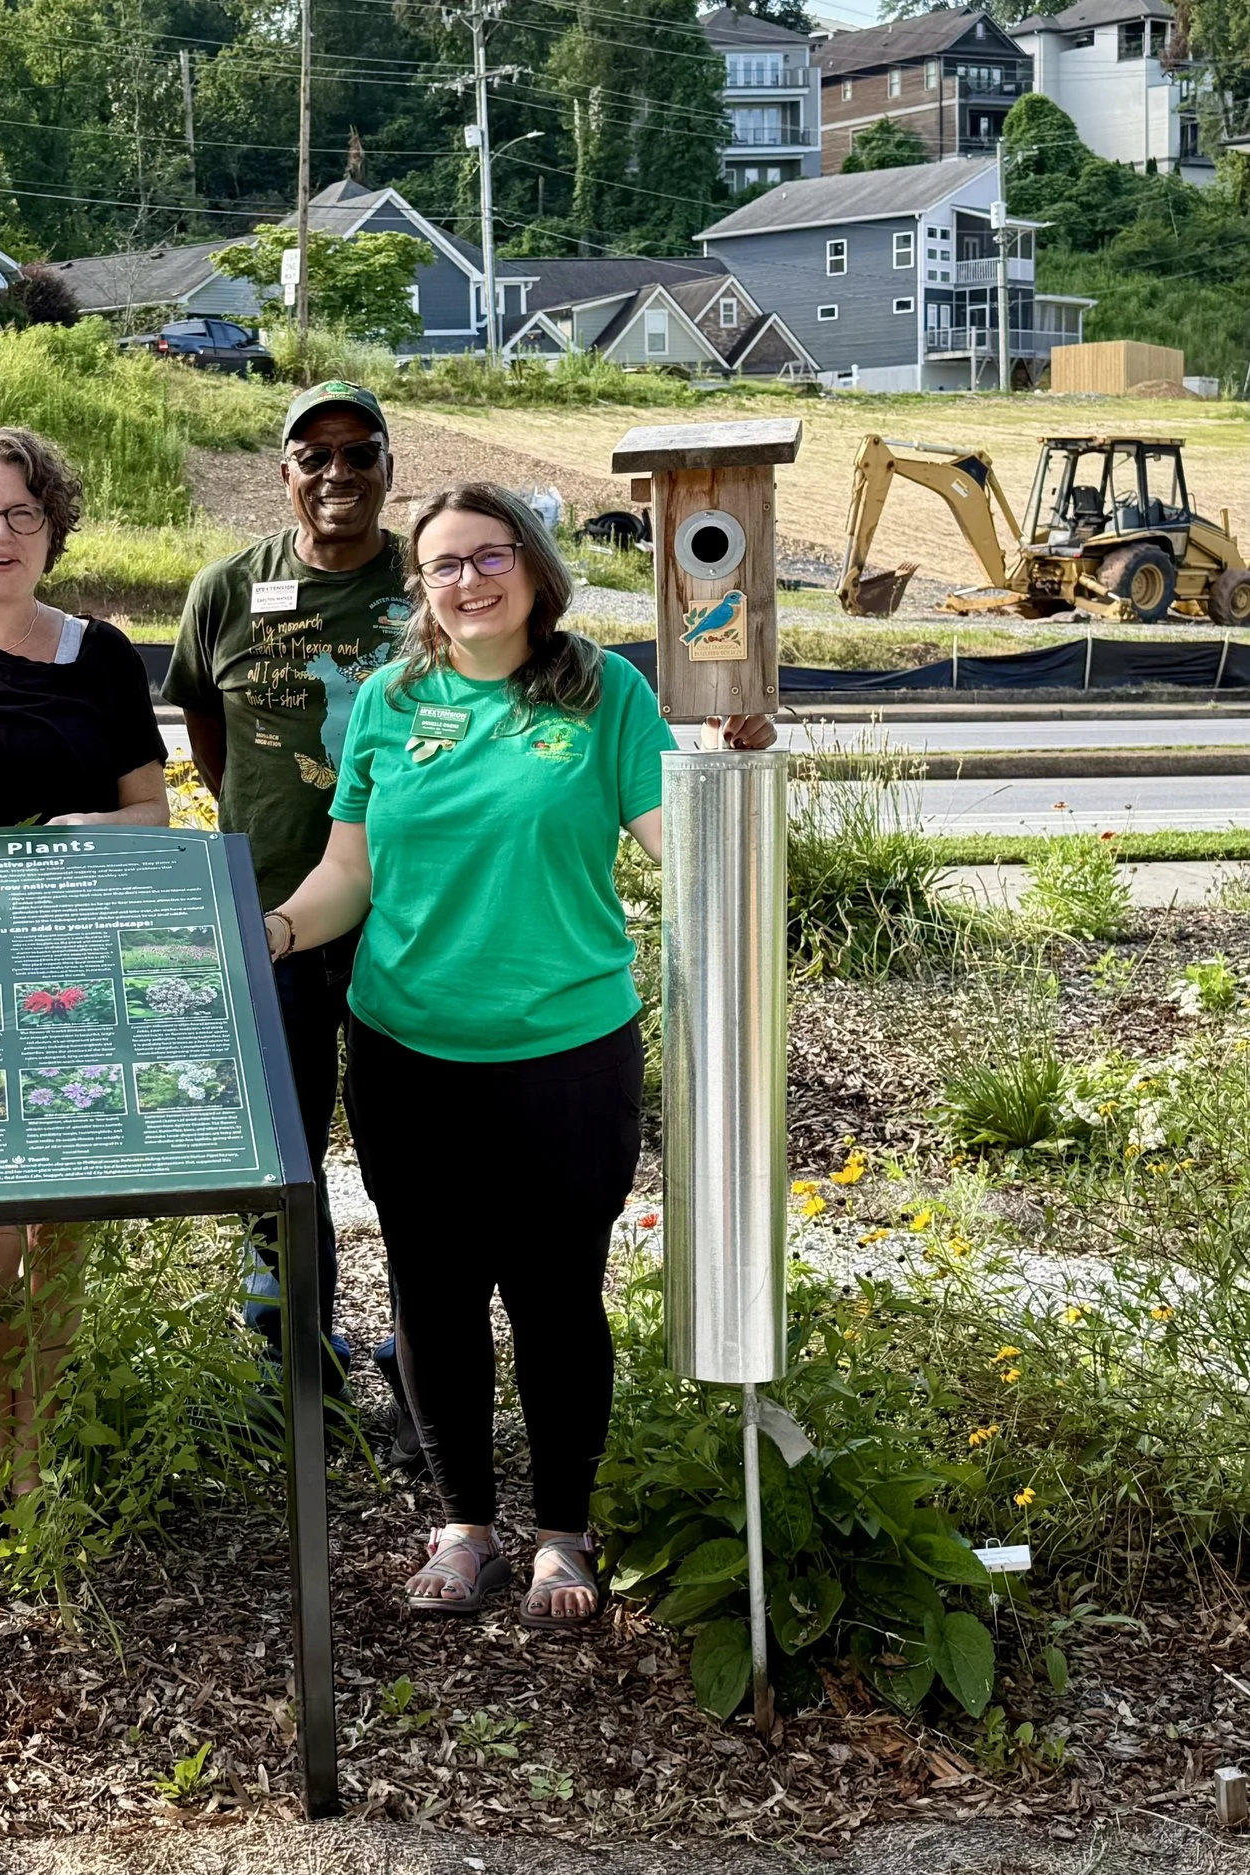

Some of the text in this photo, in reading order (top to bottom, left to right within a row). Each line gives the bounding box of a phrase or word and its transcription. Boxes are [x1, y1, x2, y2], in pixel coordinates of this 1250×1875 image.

[251, 613, 323, 642] My monarch
[291, 635, 333, 660] Mexico
[337, 637, 360, 658] and
[247, 661, 261, 683] all
[262, 661, 270, 684] I
[271, 661, 291, 689] got
[244, 687, 309, 710] this t-shirt
[254, 738, 282, 748] MIGRATION
[7, 839, 96, 855] Plants
[26, 858, 65, 868] plants?
[23, 882, 57, 890] native
[59, 880, 98, 889] plants?
[30, 923, 52, 932] add
[67, 923, 93, 931] your
